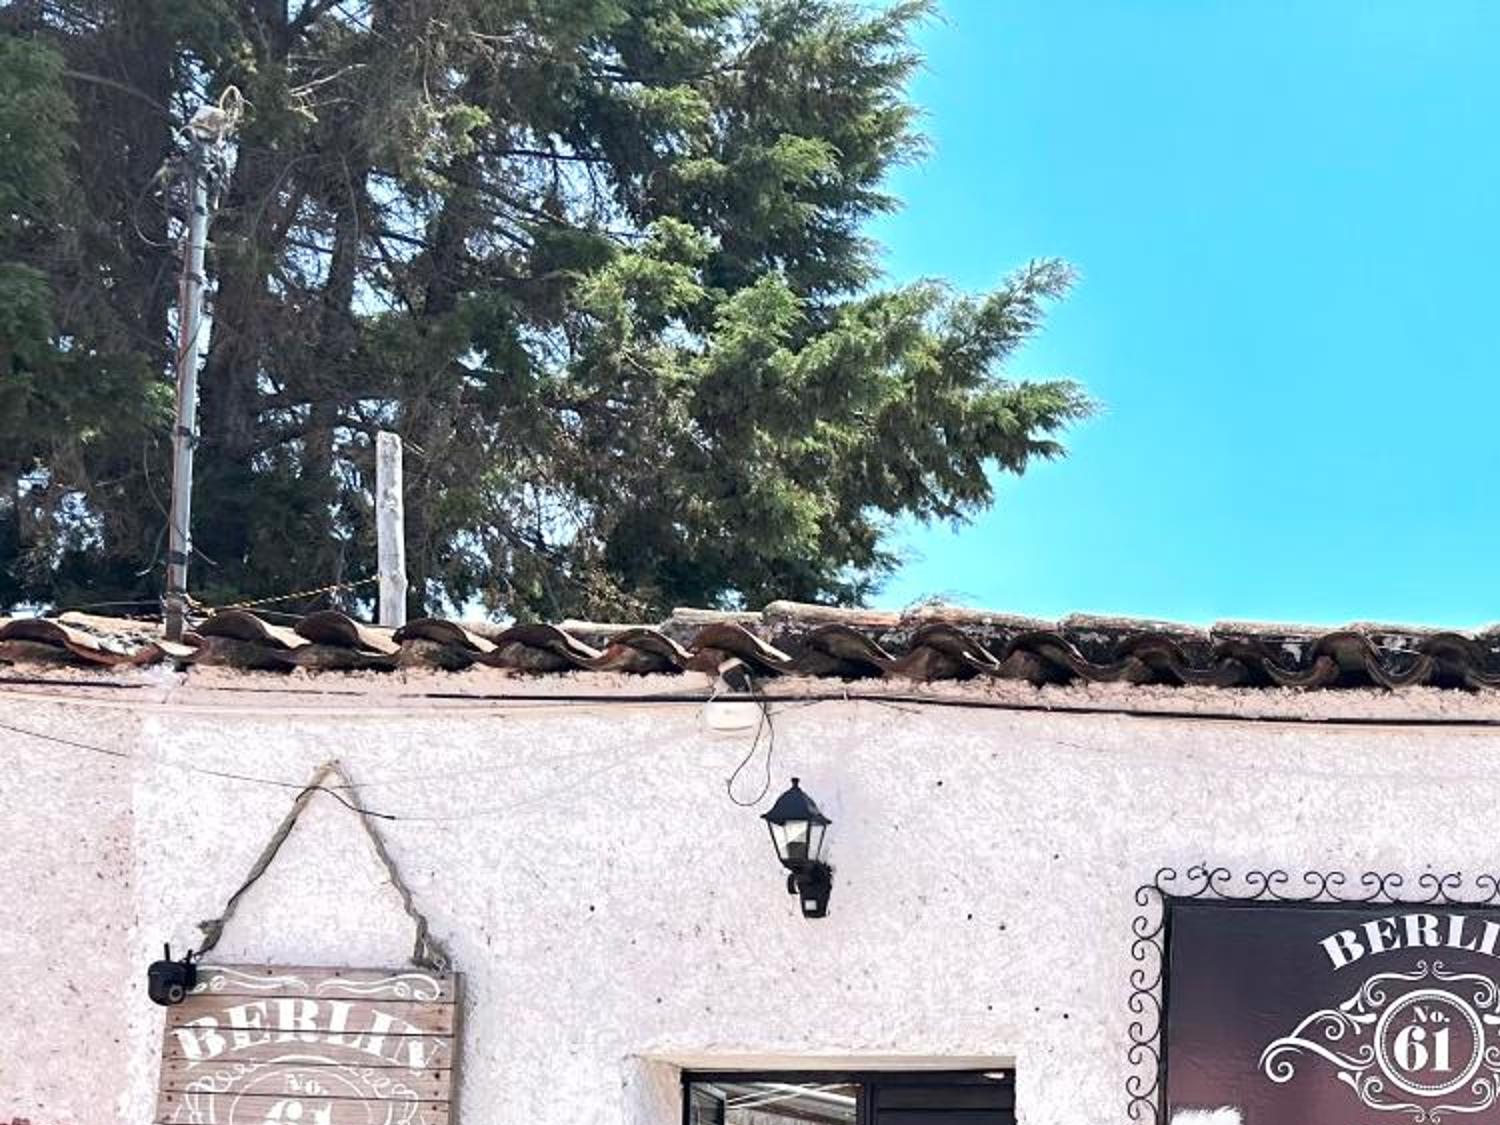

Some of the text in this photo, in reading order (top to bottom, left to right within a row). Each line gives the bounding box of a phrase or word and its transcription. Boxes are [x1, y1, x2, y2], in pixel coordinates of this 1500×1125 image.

[1411, 1006, 1450, 1023] No.
[172, 999, 447, 1077] BERLIN
[1394, 1025, 1452, 1072] 61
[285, 1073, 329, 1095] No.
